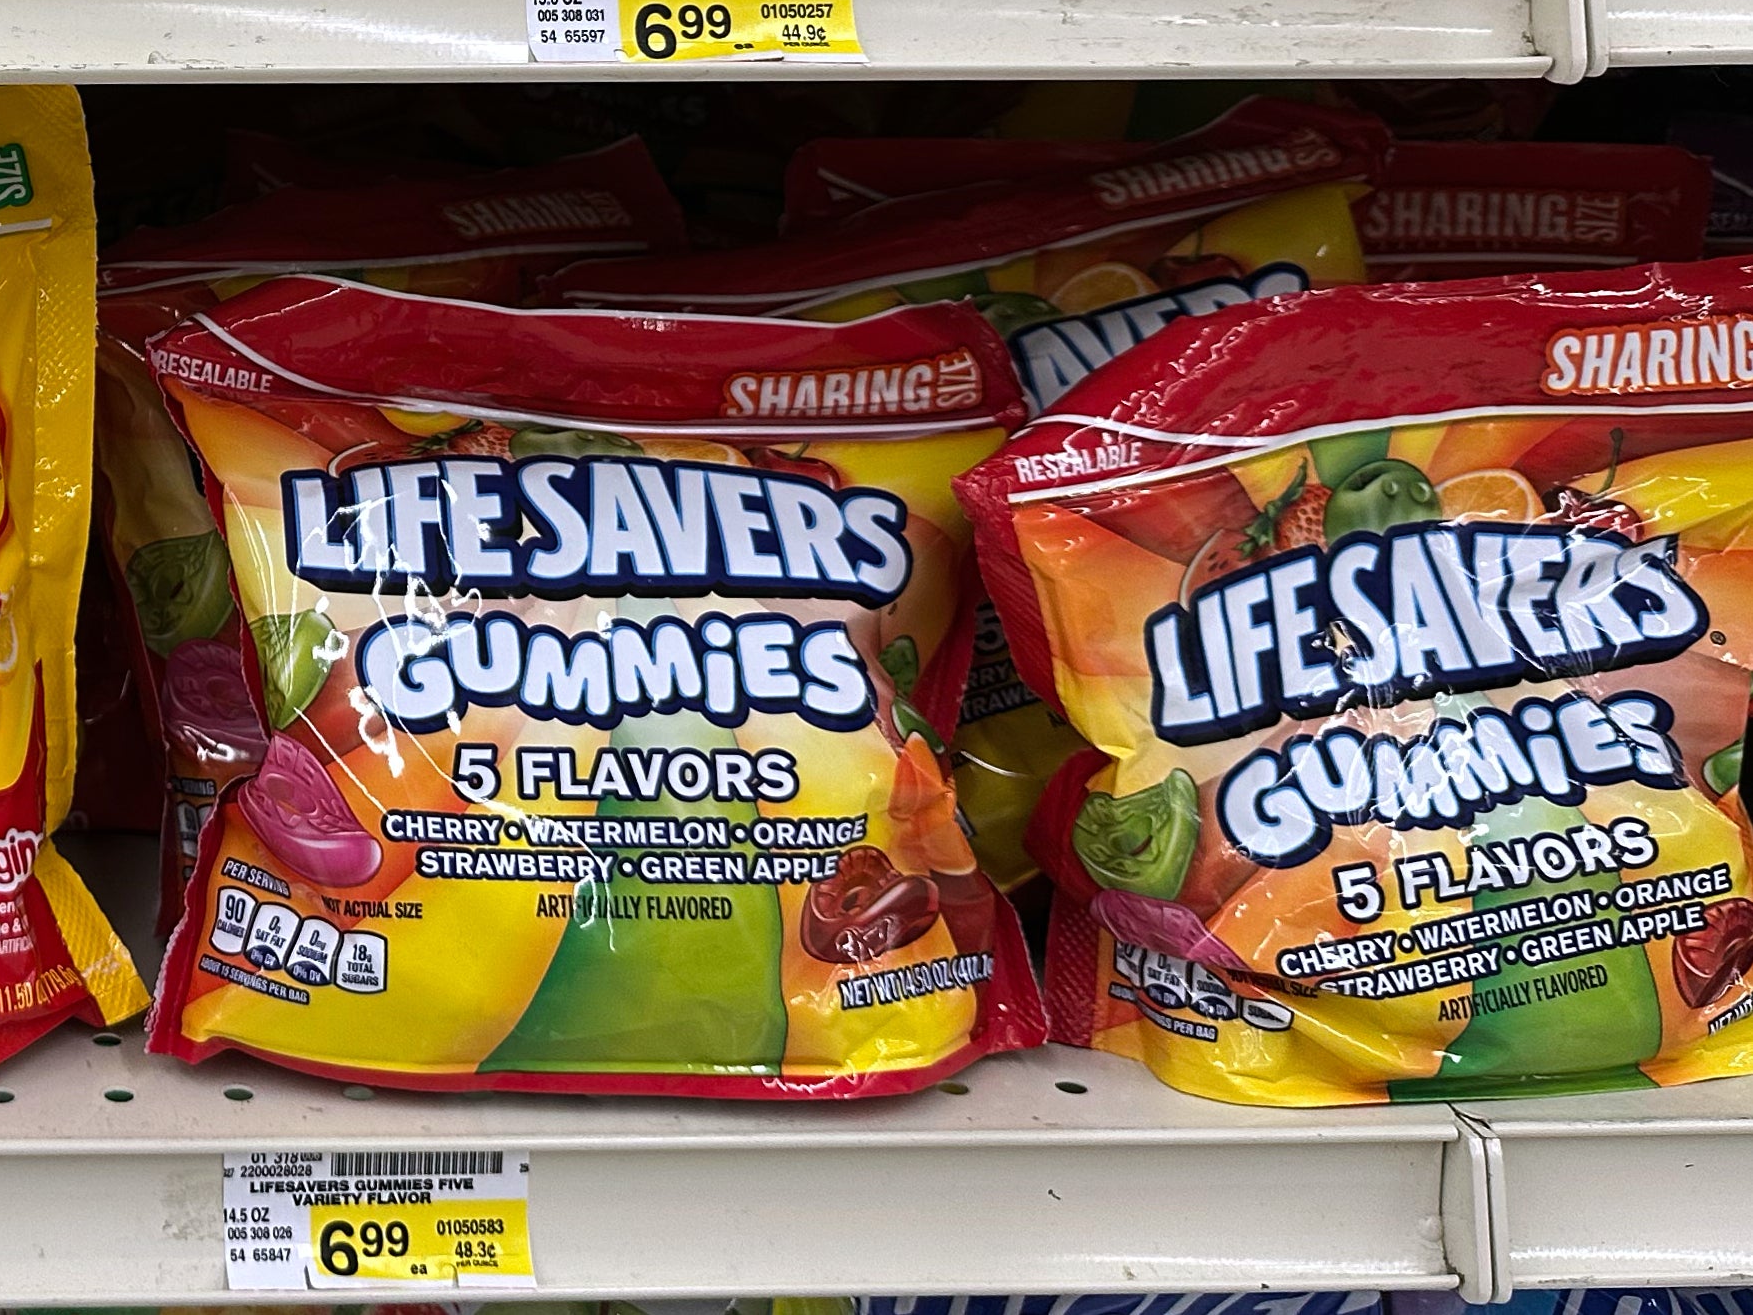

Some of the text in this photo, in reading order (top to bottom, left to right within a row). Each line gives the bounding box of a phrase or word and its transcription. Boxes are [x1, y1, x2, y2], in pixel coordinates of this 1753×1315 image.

[761, 4, 833, 19] 01050257
[782, 25, 826, 41] 44.9¢
[1365, 192, 1620, 242] SHARING SIZE
[156, 349, 272, 395] RESEALABLE
[1546, 327, 1753, 392] SHARING
[727, 351, 980, 419] SHARING SIZE
[1014, 444, 1141, 483] RESEALABLE
[526, 460, 908, 594] SAVERS
[1330, 533, 1698, 686] SAVERS
[454, 747, 798, 802] 5 FLAVORS
[385, 815, 866, 849] CHERRY WATERMELON ORANGE
[418, 851, 839, 882] STRAWBERRY GREEN APPLE
[1337, 820, 1657, 921] 5 FLAVORS
[536, 895, 733, 922] ARTIFICIALLY FLAVORED
[1277, 869, 1732, 978] CHERRY WATERMELON ORANGE
[1319, 905, 1705, 999] STRAWBERRY GREEN APPLE
[1438, 966, 1608, 1023] ARTIFICIALLY FLAVORED
[241, 1165, 312, 1177] 2200028028
[250, 1178, 474, 1193] LIFESAVERS GUMMIES FIVE
[223, 1208, 270, 1222] 14.5 OZ
[293, 1192, 432, 1205] VARIETY FLAVOR
[437, 1219, 504, 1235] 01050583
[455, 1241, 496, 1259] 48.3¢
